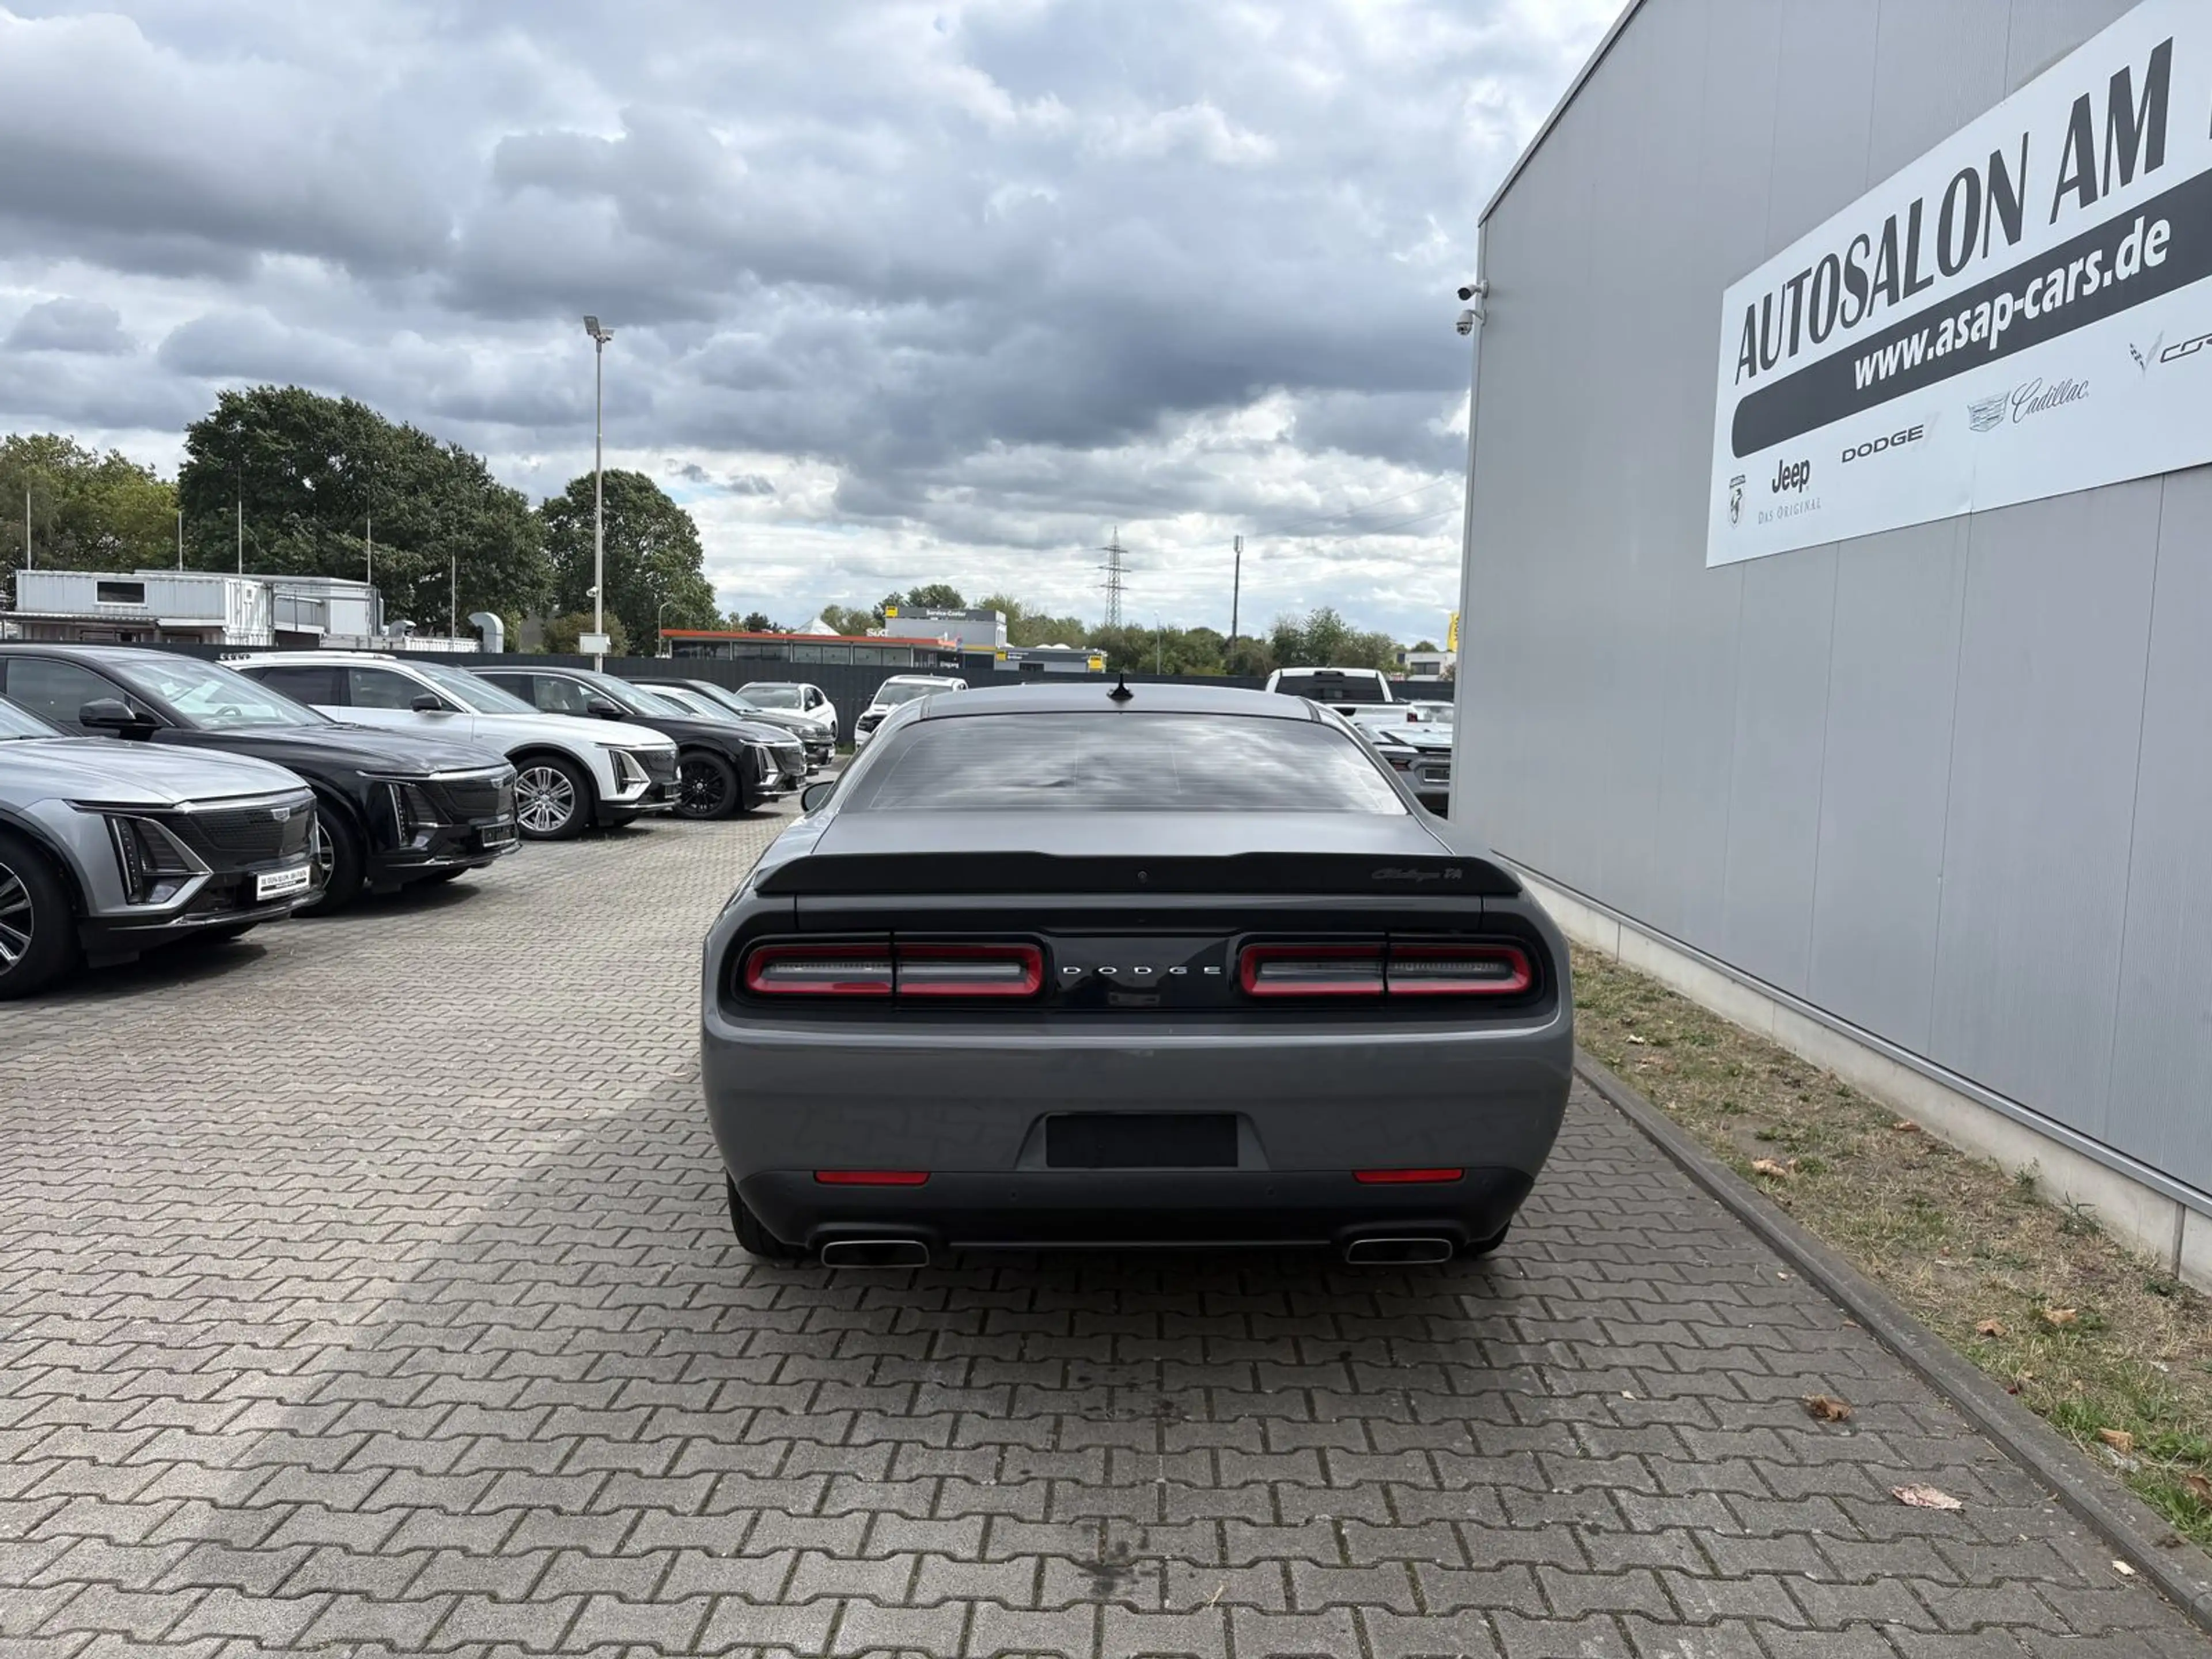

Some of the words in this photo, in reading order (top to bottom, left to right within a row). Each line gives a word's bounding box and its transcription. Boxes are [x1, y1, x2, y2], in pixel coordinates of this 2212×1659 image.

[1735, 131, 2029, 385] AUTOSALON
[2049, 36, 2173, 225] AM
[1855, 215, 2171, 390] www.asap-cars.de
[2011, 377, 2089, 424] Cadillac
[1842, 424, 1924, 463] DODGE
[1772, 459, 1810, 493] Jeep
[1063, 966, 1221, 974] DODGE
